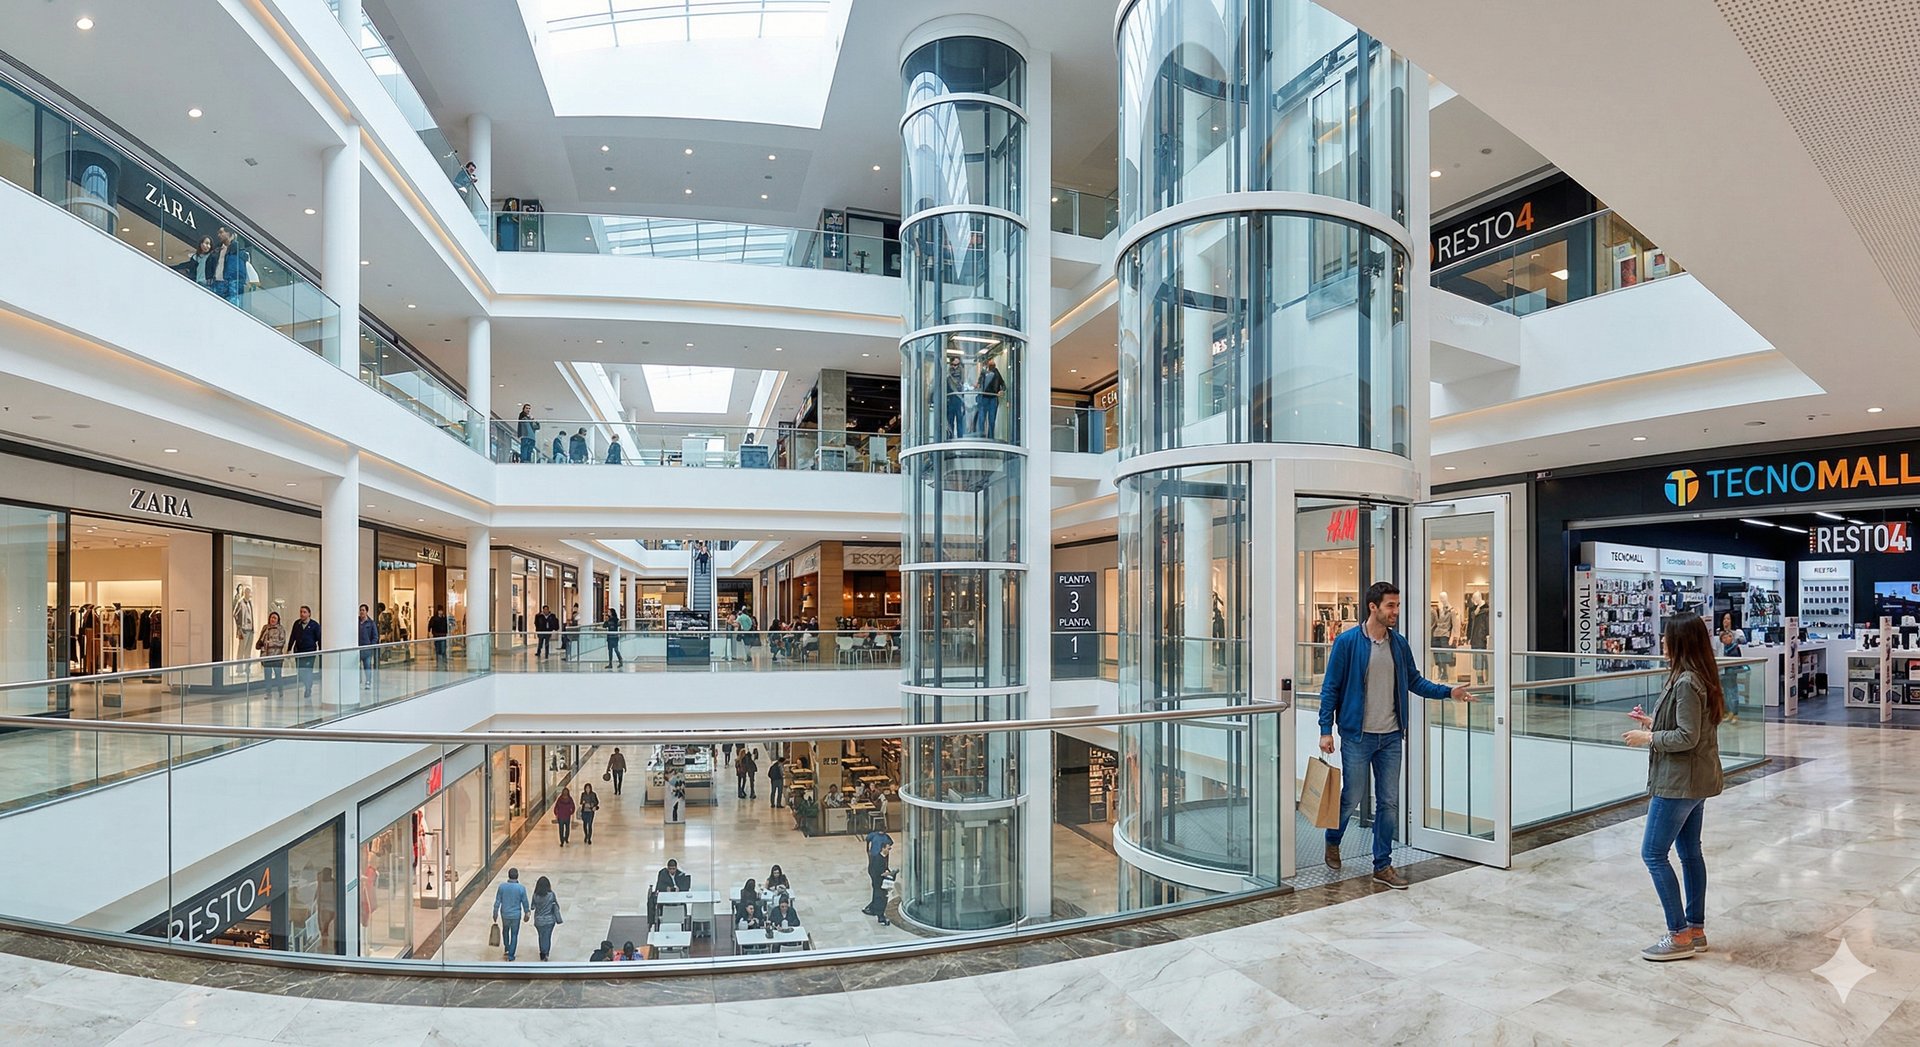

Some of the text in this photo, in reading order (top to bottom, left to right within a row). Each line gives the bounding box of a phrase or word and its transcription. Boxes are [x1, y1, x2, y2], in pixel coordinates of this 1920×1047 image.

[145, 182, 197, 230] ZARA
[1438, 202, 1535, 262] RESTO4
[1706, 453, 1920, 499] TECNOMALL
[129, 488, 193, 519] ZARA
[1059, 575, 1091, 584] PLANTA
[1069, 591, 1080, 613] 3
[1059, 618, 1092, 627] PLANTA
[1070, 635, 1079, 654] 1
[167, 867, 273, 942] RESTO4
